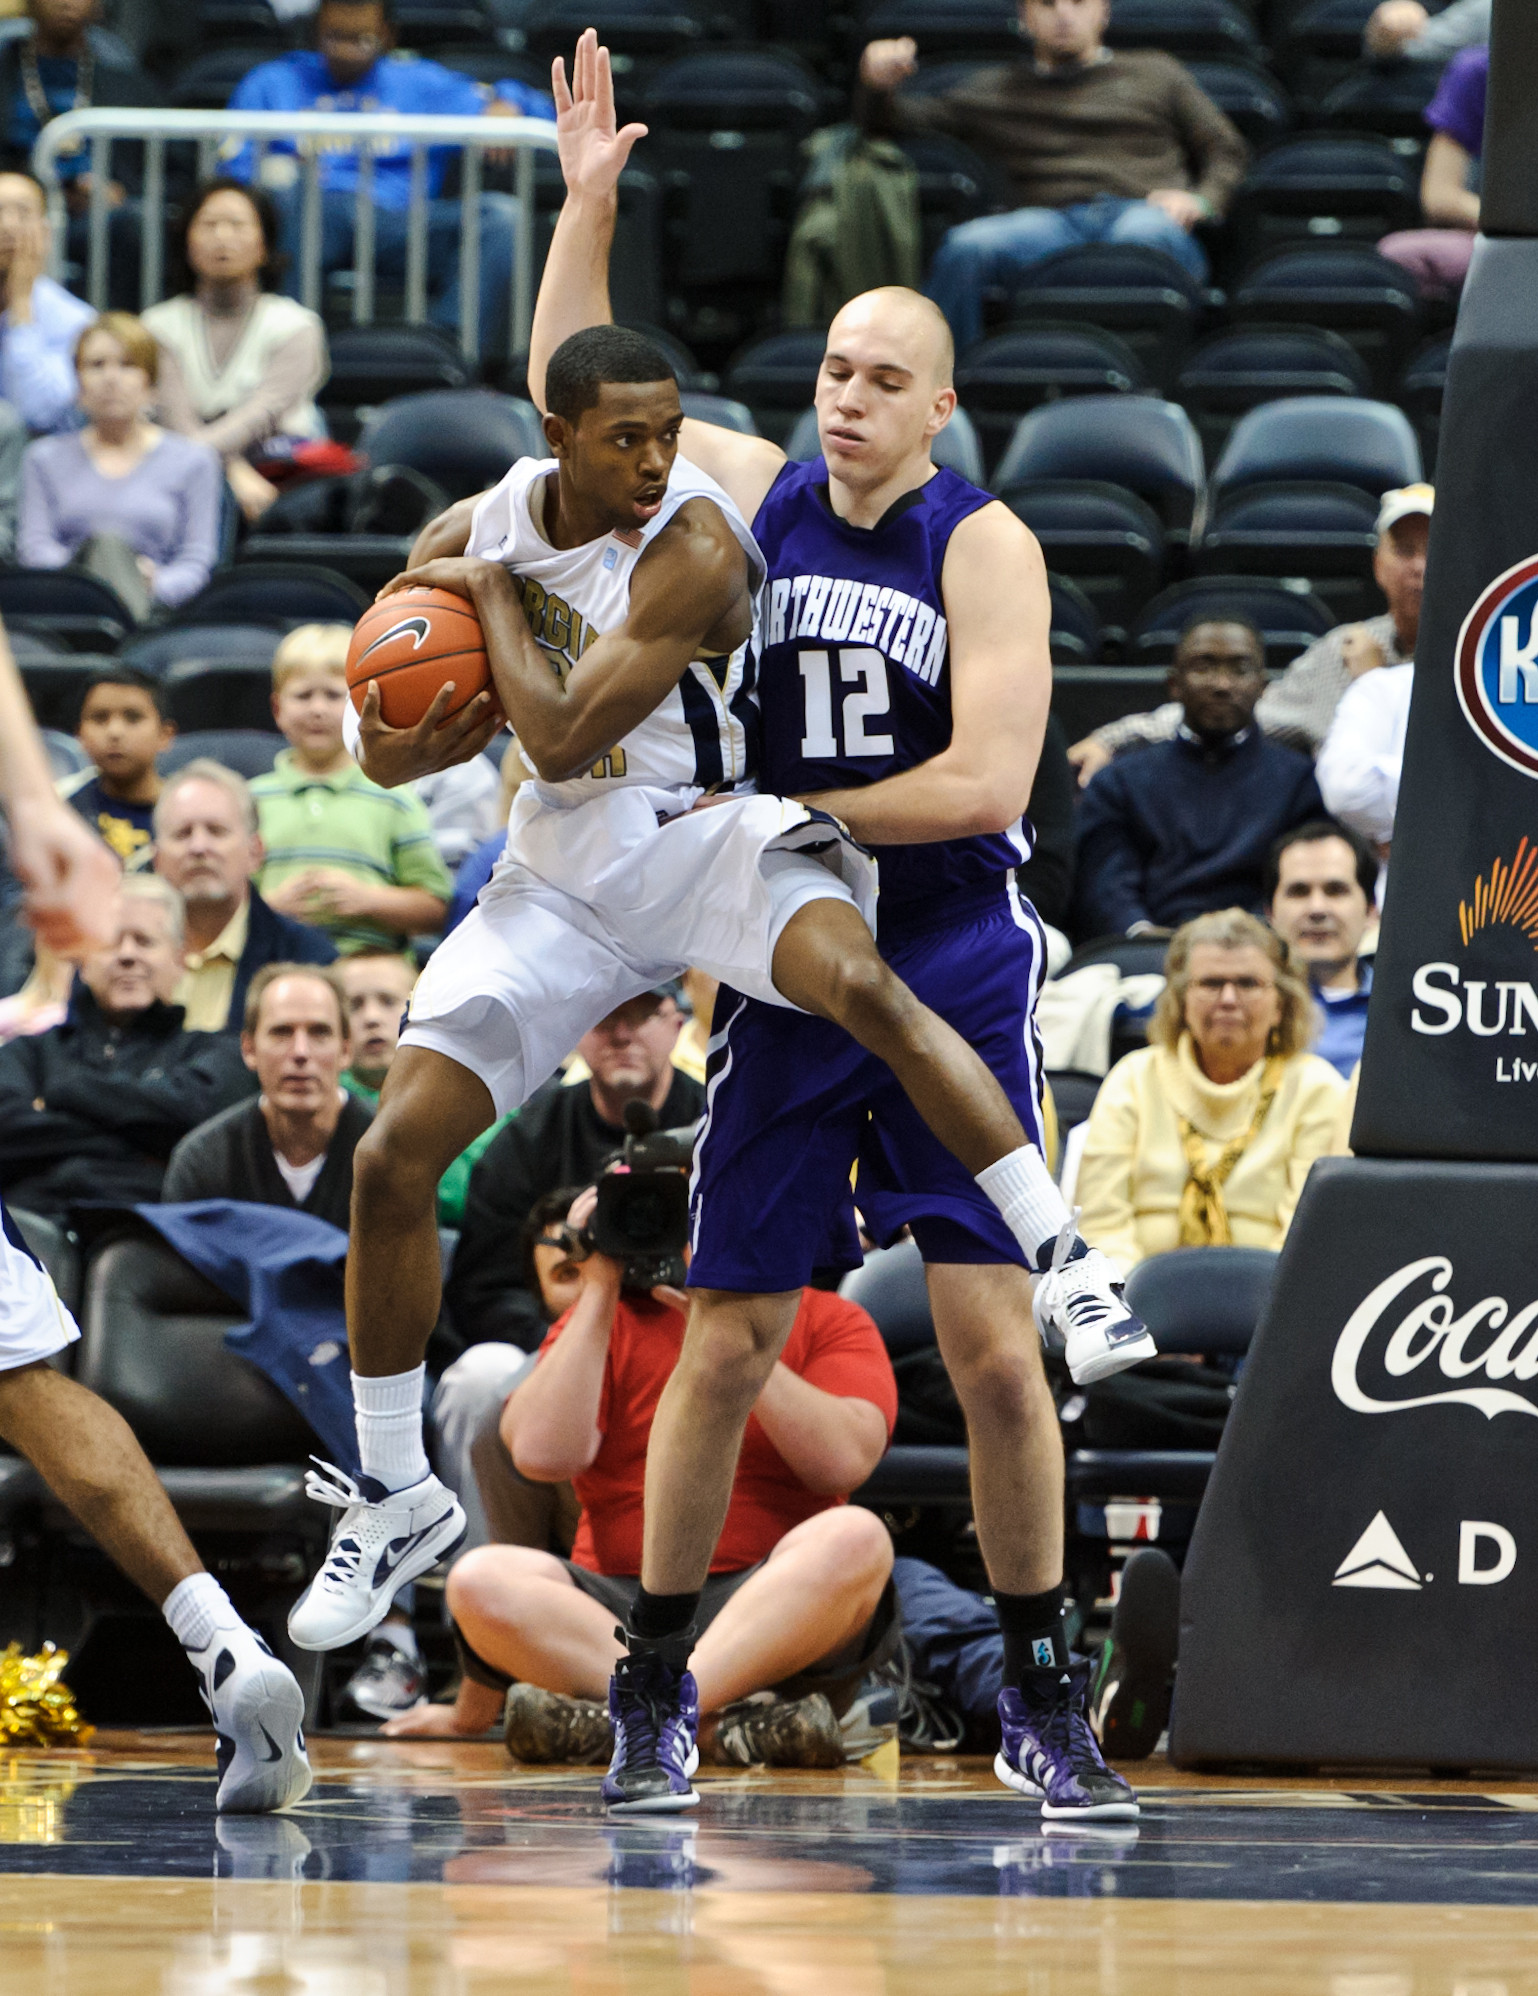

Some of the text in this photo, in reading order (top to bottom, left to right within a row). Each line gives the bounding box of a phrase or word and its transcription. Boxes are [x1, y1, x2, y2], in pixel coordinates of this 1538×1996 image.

[798, 647, 895, 758] 12
[1496, 1056, 1538, 1082] Liv
[1331, 1255, 1538, 1421] Coca
[1458, 1520, 1517, 1585] D
